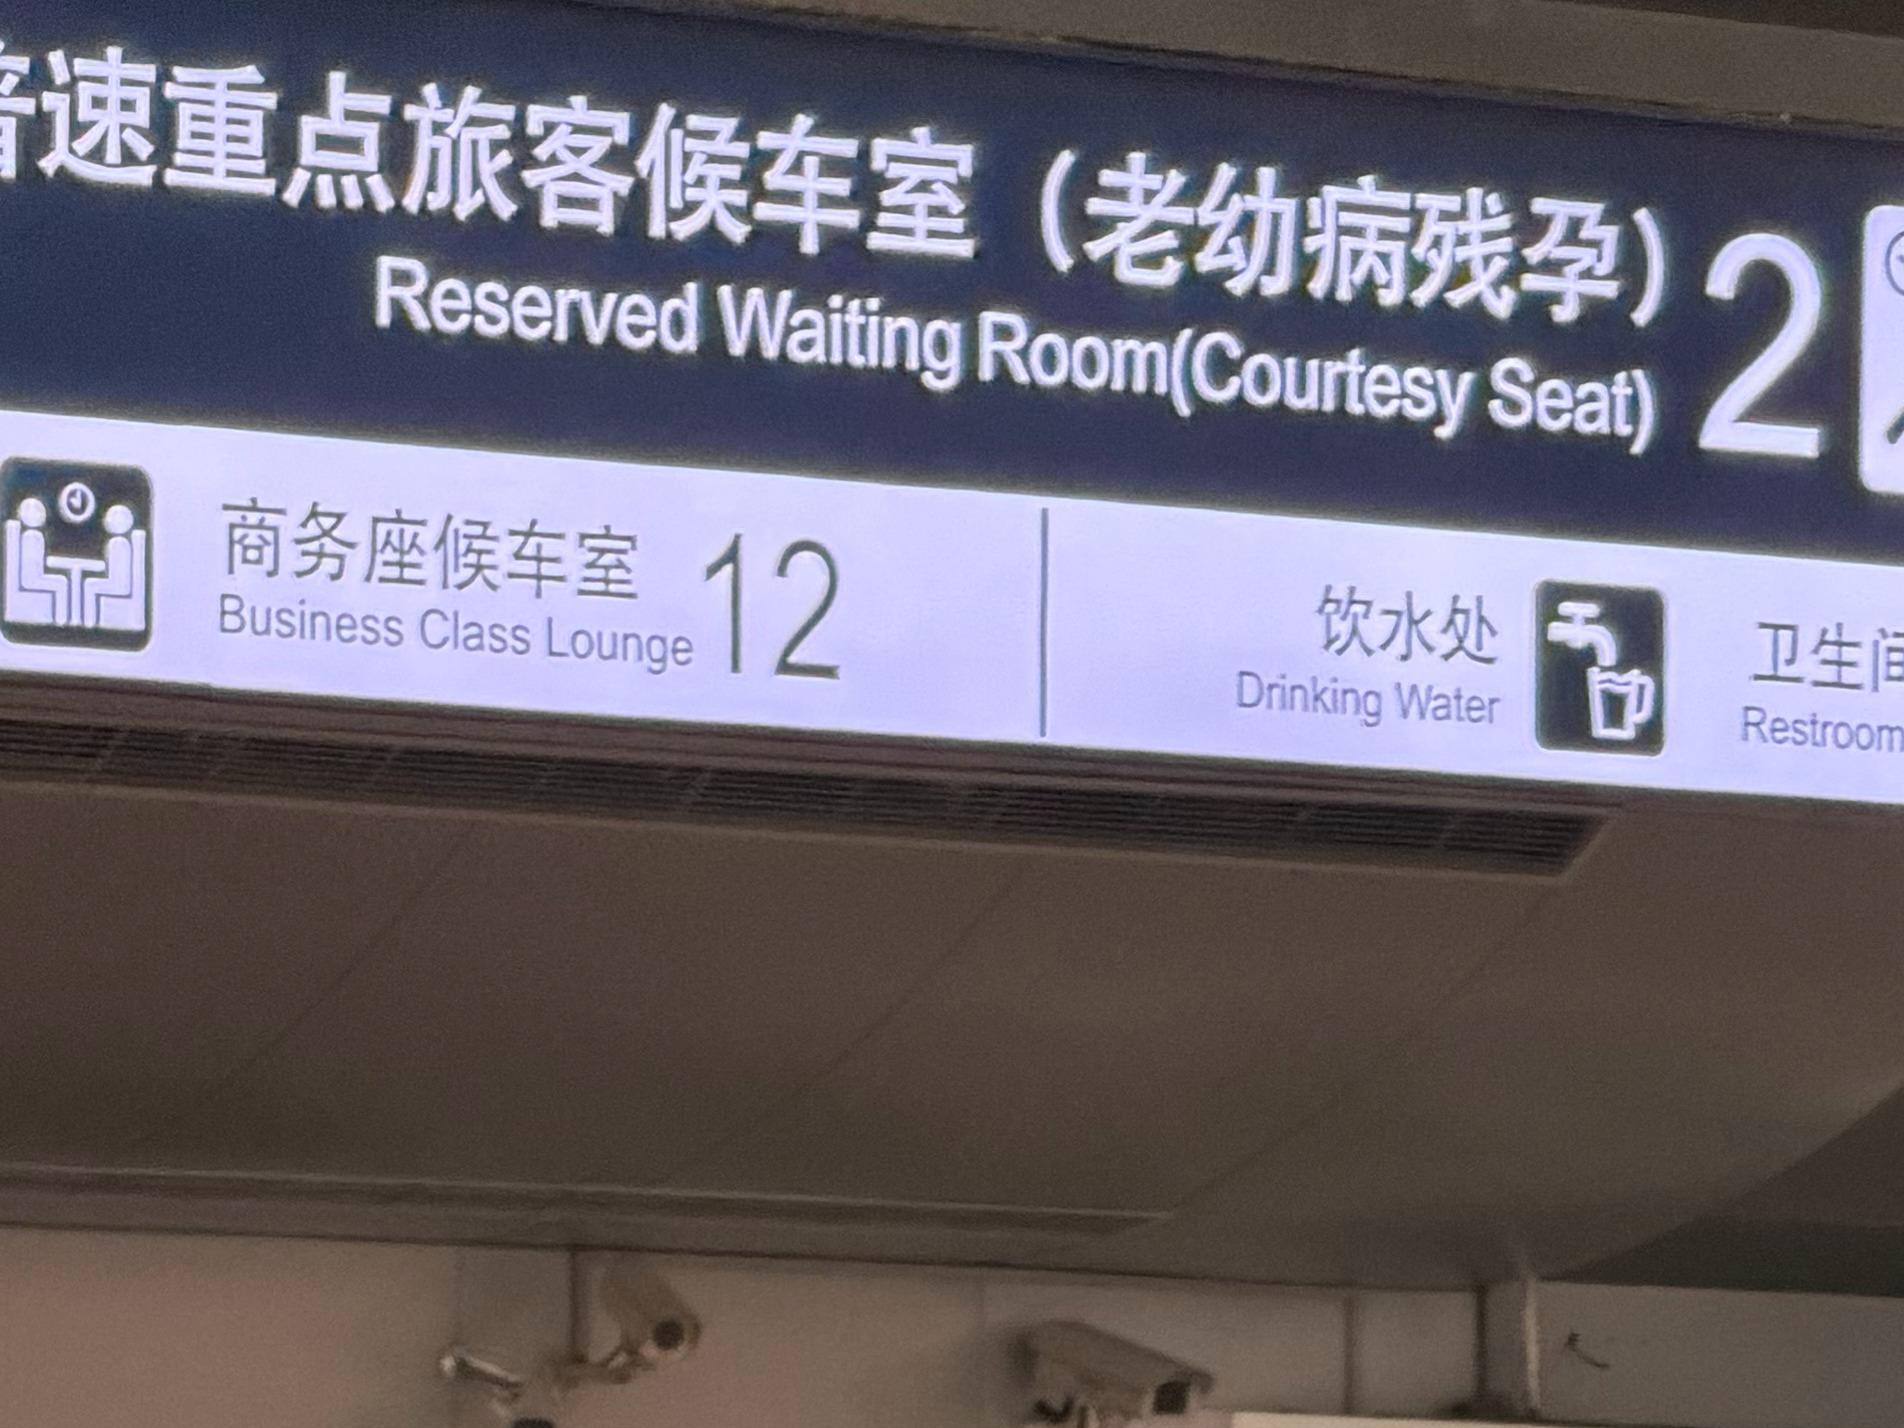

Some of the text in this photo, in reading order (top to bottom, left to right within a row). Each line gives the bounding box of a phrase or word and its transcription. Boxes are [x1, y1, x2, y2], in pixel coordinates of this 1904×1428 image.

[376, 255, 1654, 456] Reserved Waiting Room(Courtesy Seat)
[1699, 232, 1823, 459] 2
[220, 498, 640, 602] 商务座候车室
[218, 596, 694, 675] Business Class Lounge
[702, 532, 841, 680] 12
[1317, 585, 1500, 667] 饮水处
[1236, 671, 1501, 731] Drinking Water
